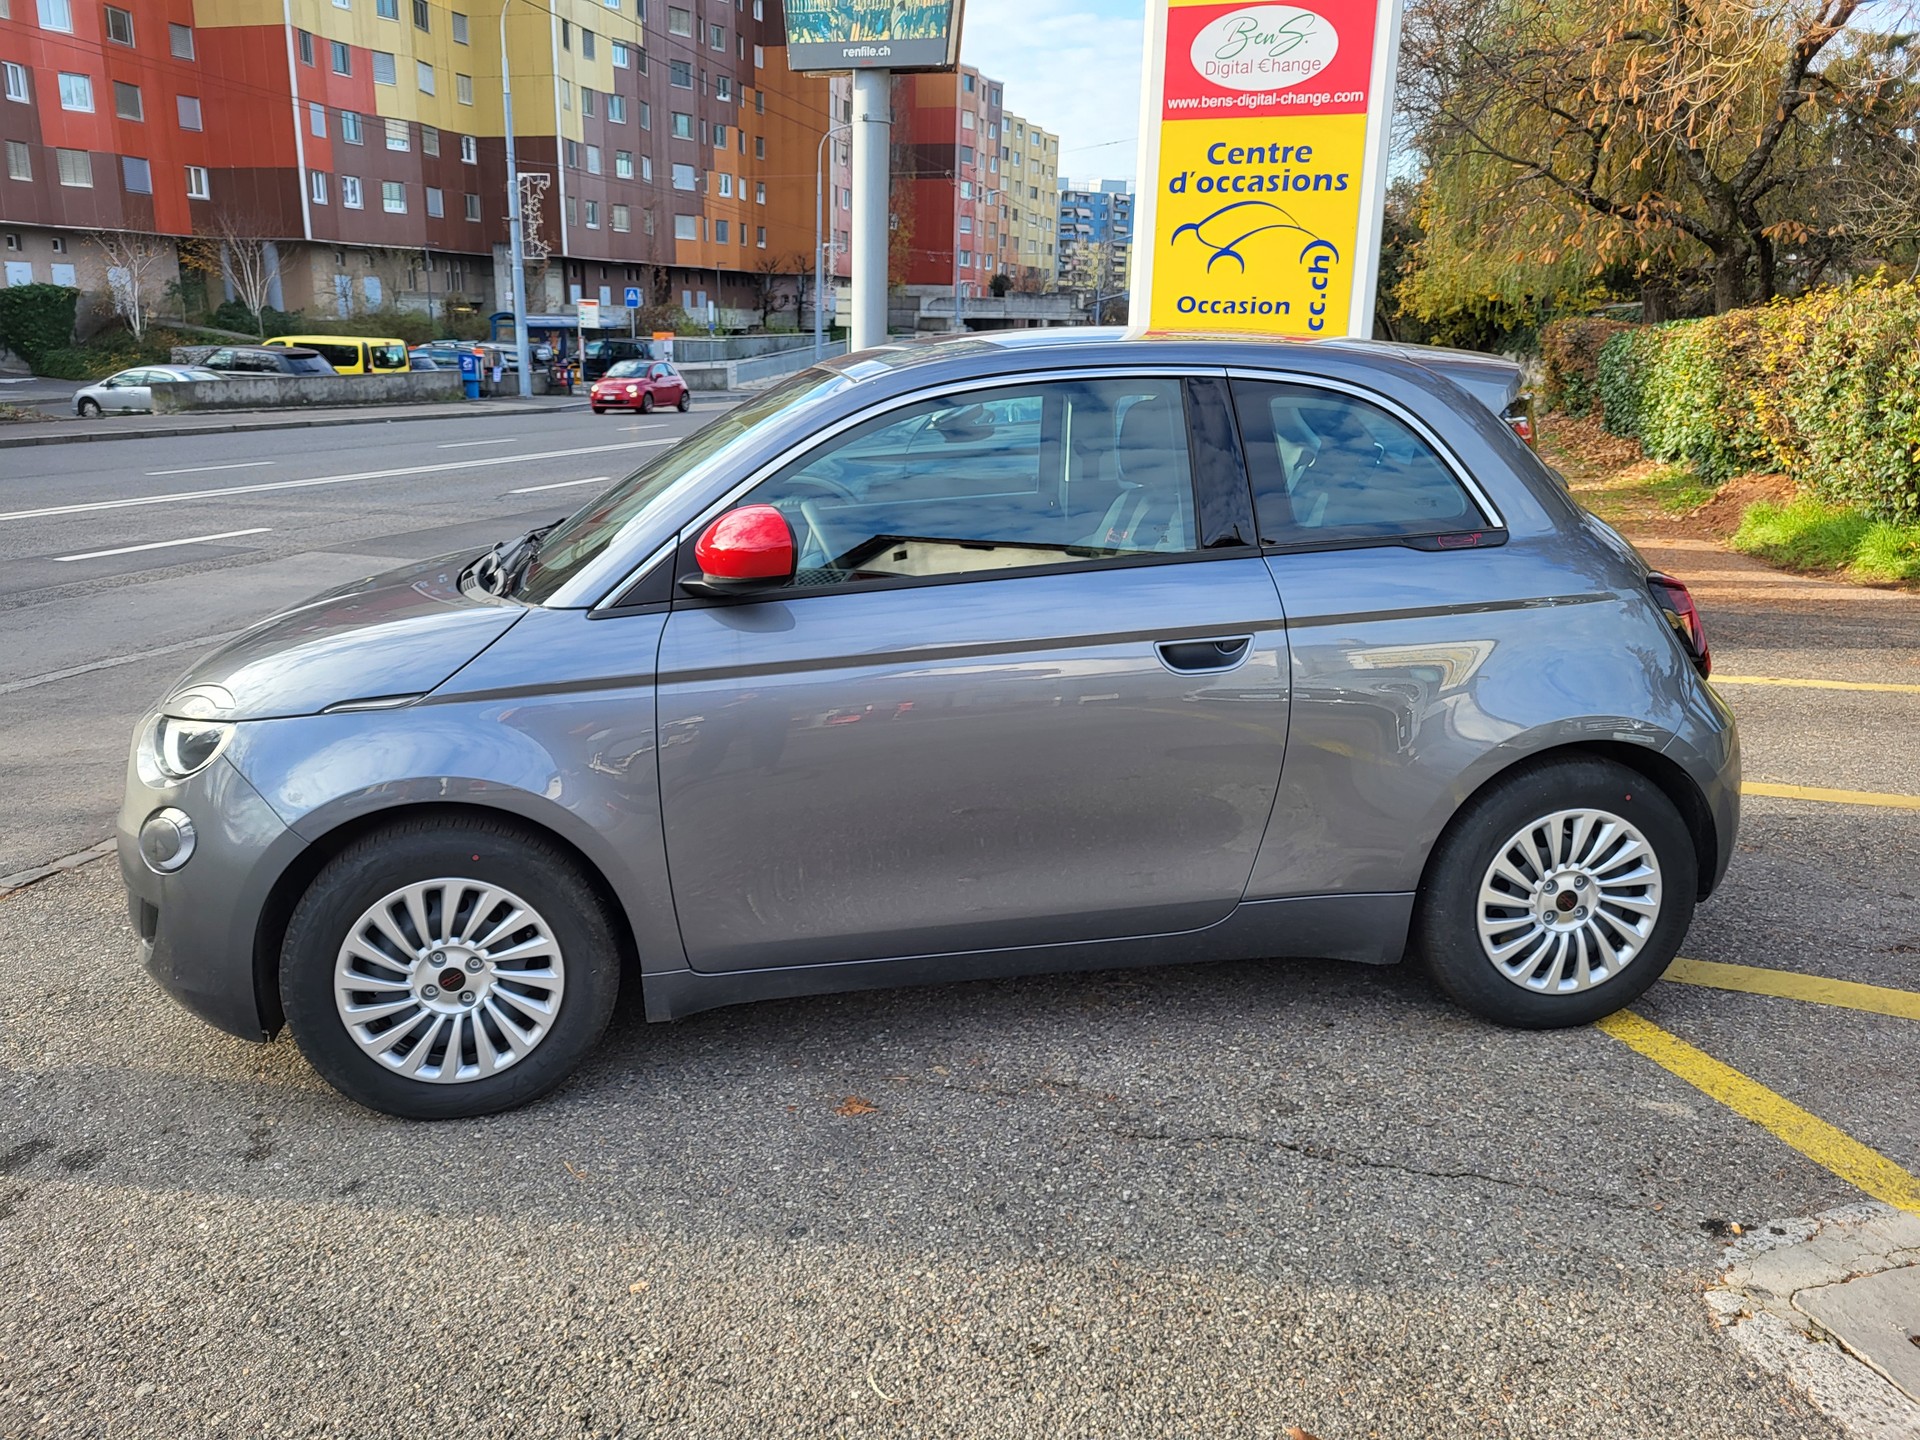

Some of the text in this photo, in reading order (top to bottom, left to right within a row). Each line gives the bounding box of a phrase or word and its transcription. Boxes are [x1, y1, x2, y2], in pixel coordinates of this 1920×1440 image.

[842, 45, 891, 58] renfile.ch
[1204, 59, 1254, 79] Digital
[1167, 90, 1364, 109] www.bens-digital-change.com
[1206, 142, 1313, 166] Centre
[1168, 168, 1349, 194] d'occasions
[1307, 255, 1330, 331] cc.ch
[1177, 296, 1290, 315] Occasion
